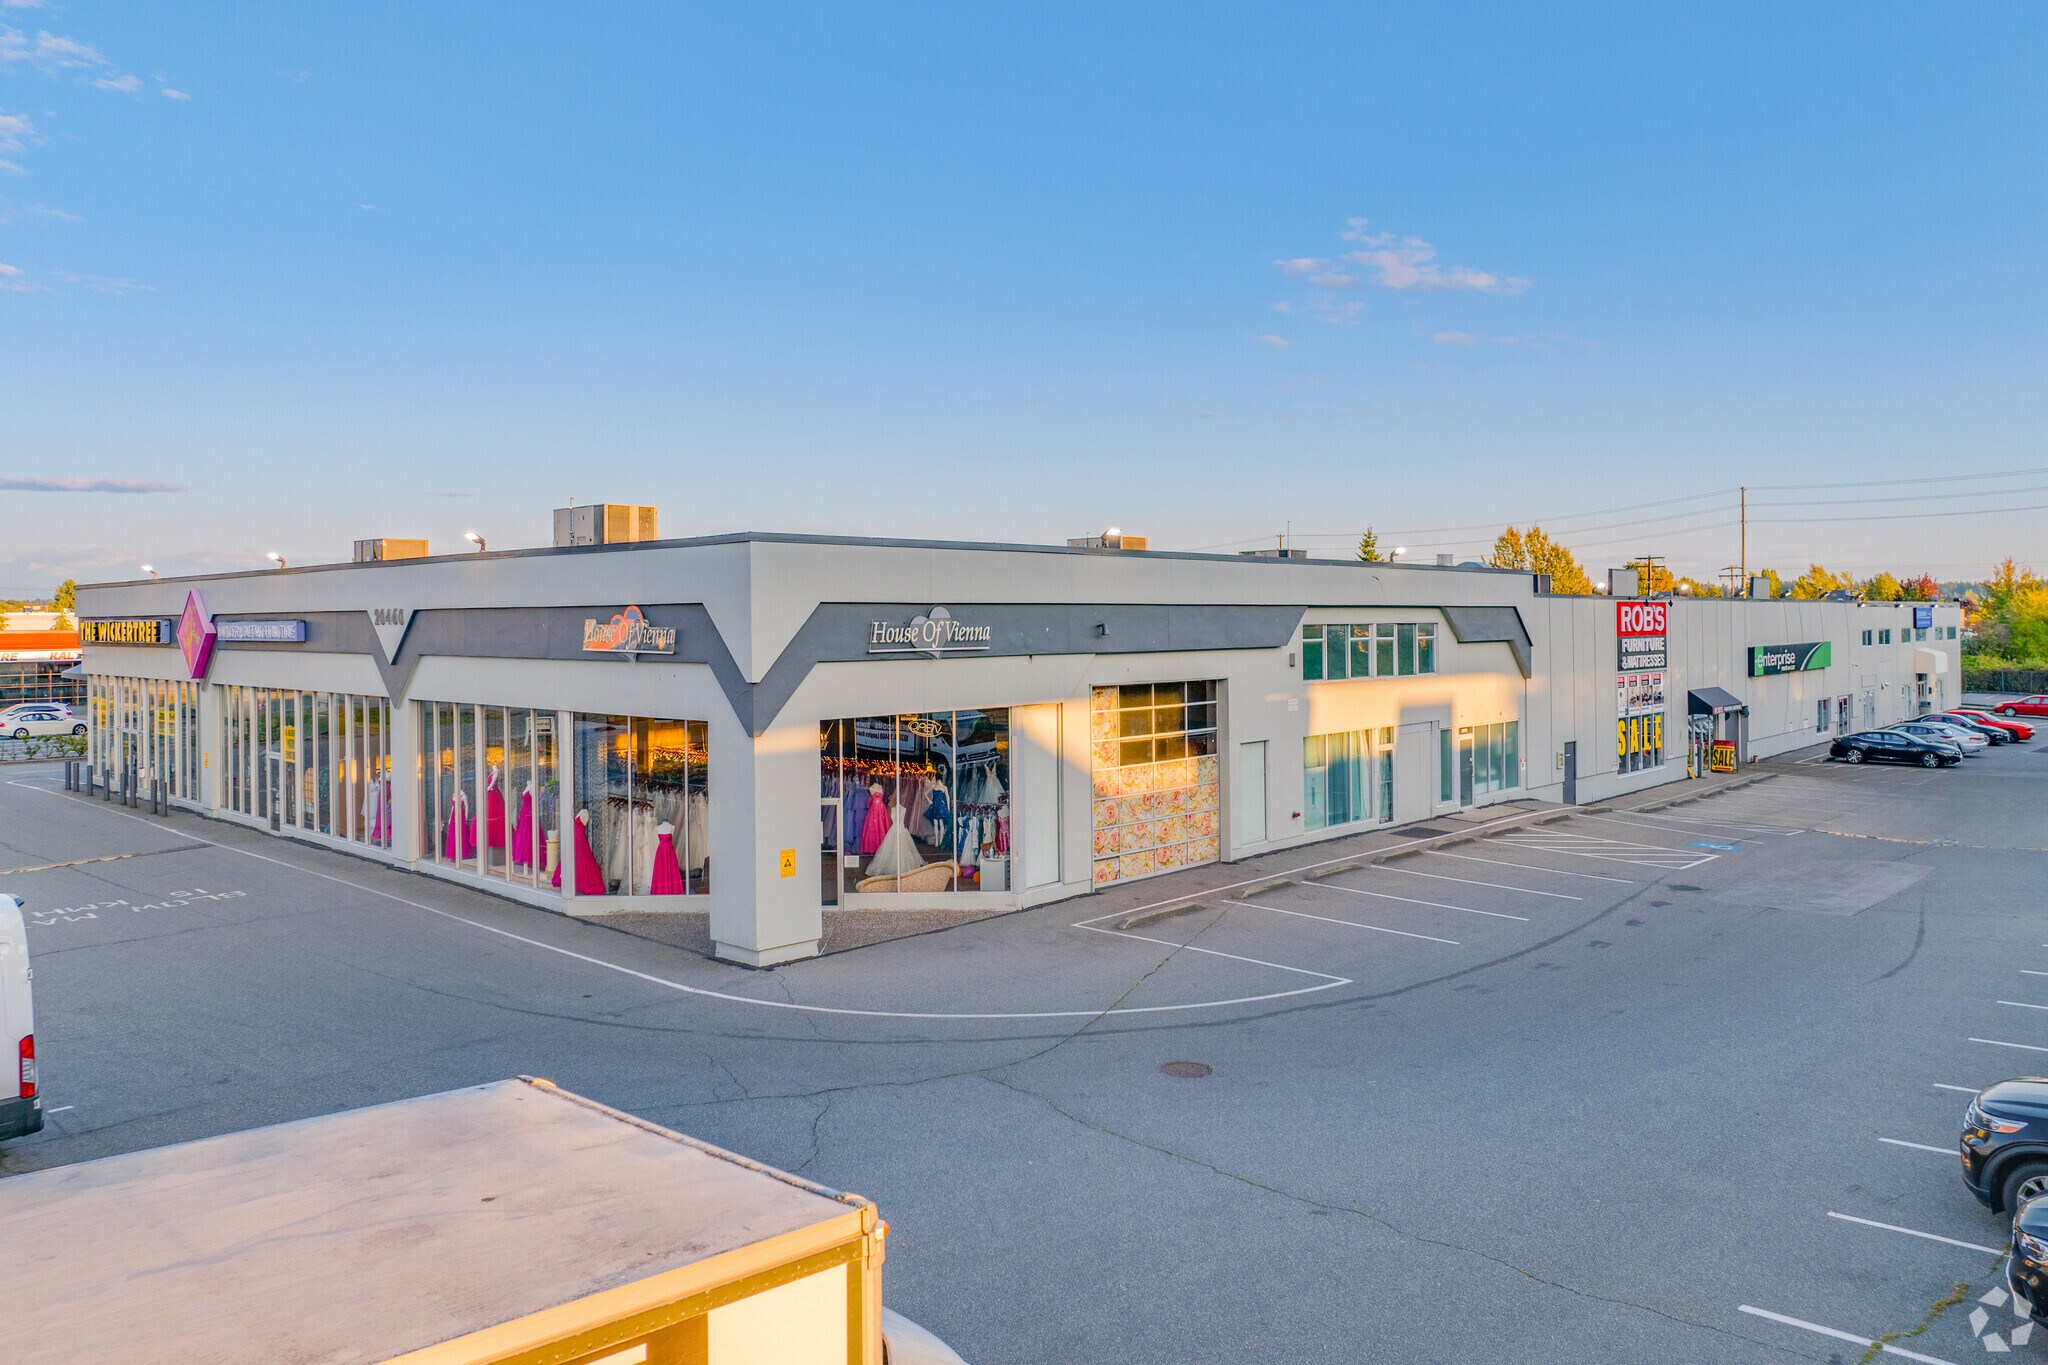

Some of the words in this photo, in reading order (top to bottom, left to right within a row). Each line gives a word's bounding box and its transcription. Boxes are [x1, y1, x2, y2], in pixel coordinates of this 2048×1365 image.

[1620, 605, 1665, 632] ROB'S
[80, 621, 96, 641] THE
[585, 620, 616, 643] House
[636, 621, 675, 645] Vienna
[871, 621, 919, 643] House
[922, 620, 944, 648] Of
[945, 620, 991, 641] Vienna
[1621, 637, 1665, 652] FURNITURE
[0, 652, 19, 661] RE
[1754, 649, 1796, 670] enterprise
[911, 721, 941, 734] OPEN
[1617, 715, 1662, 757] SALE
[1712, 748, 1735, 767] SALE
[28, 913, 98, 927] MA
